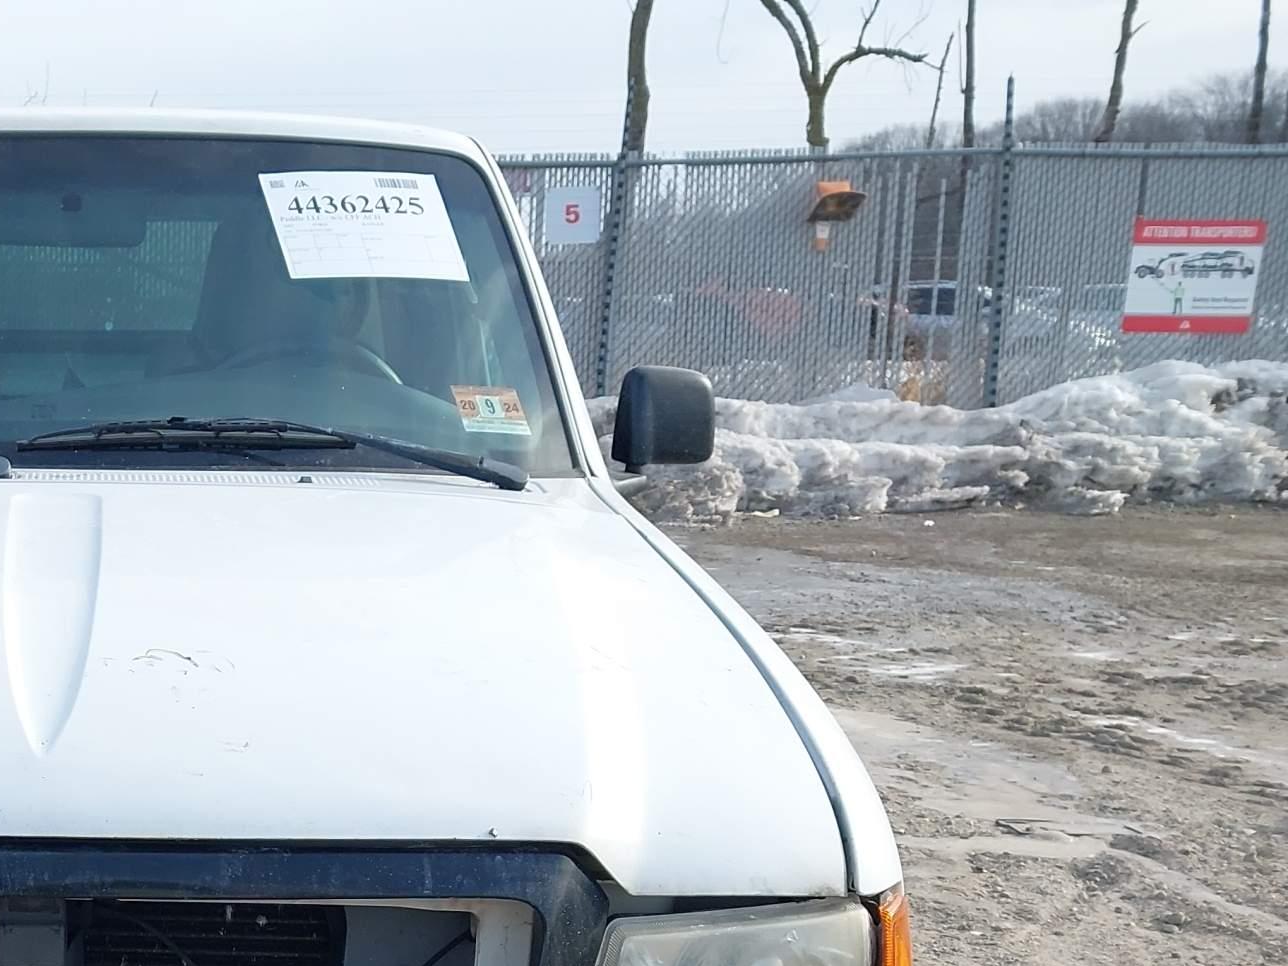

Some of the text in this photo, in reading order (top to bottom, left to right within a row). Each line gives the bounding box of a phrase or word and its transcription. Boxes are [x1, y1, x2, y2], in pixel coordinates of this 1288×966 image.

[288, 195, 424, 215] 44362425
[565, 204, 580, 224] 5
[1142, 226, 1188, 238] ATTENTION
[460, 398, 520, 414] 20 9 24
